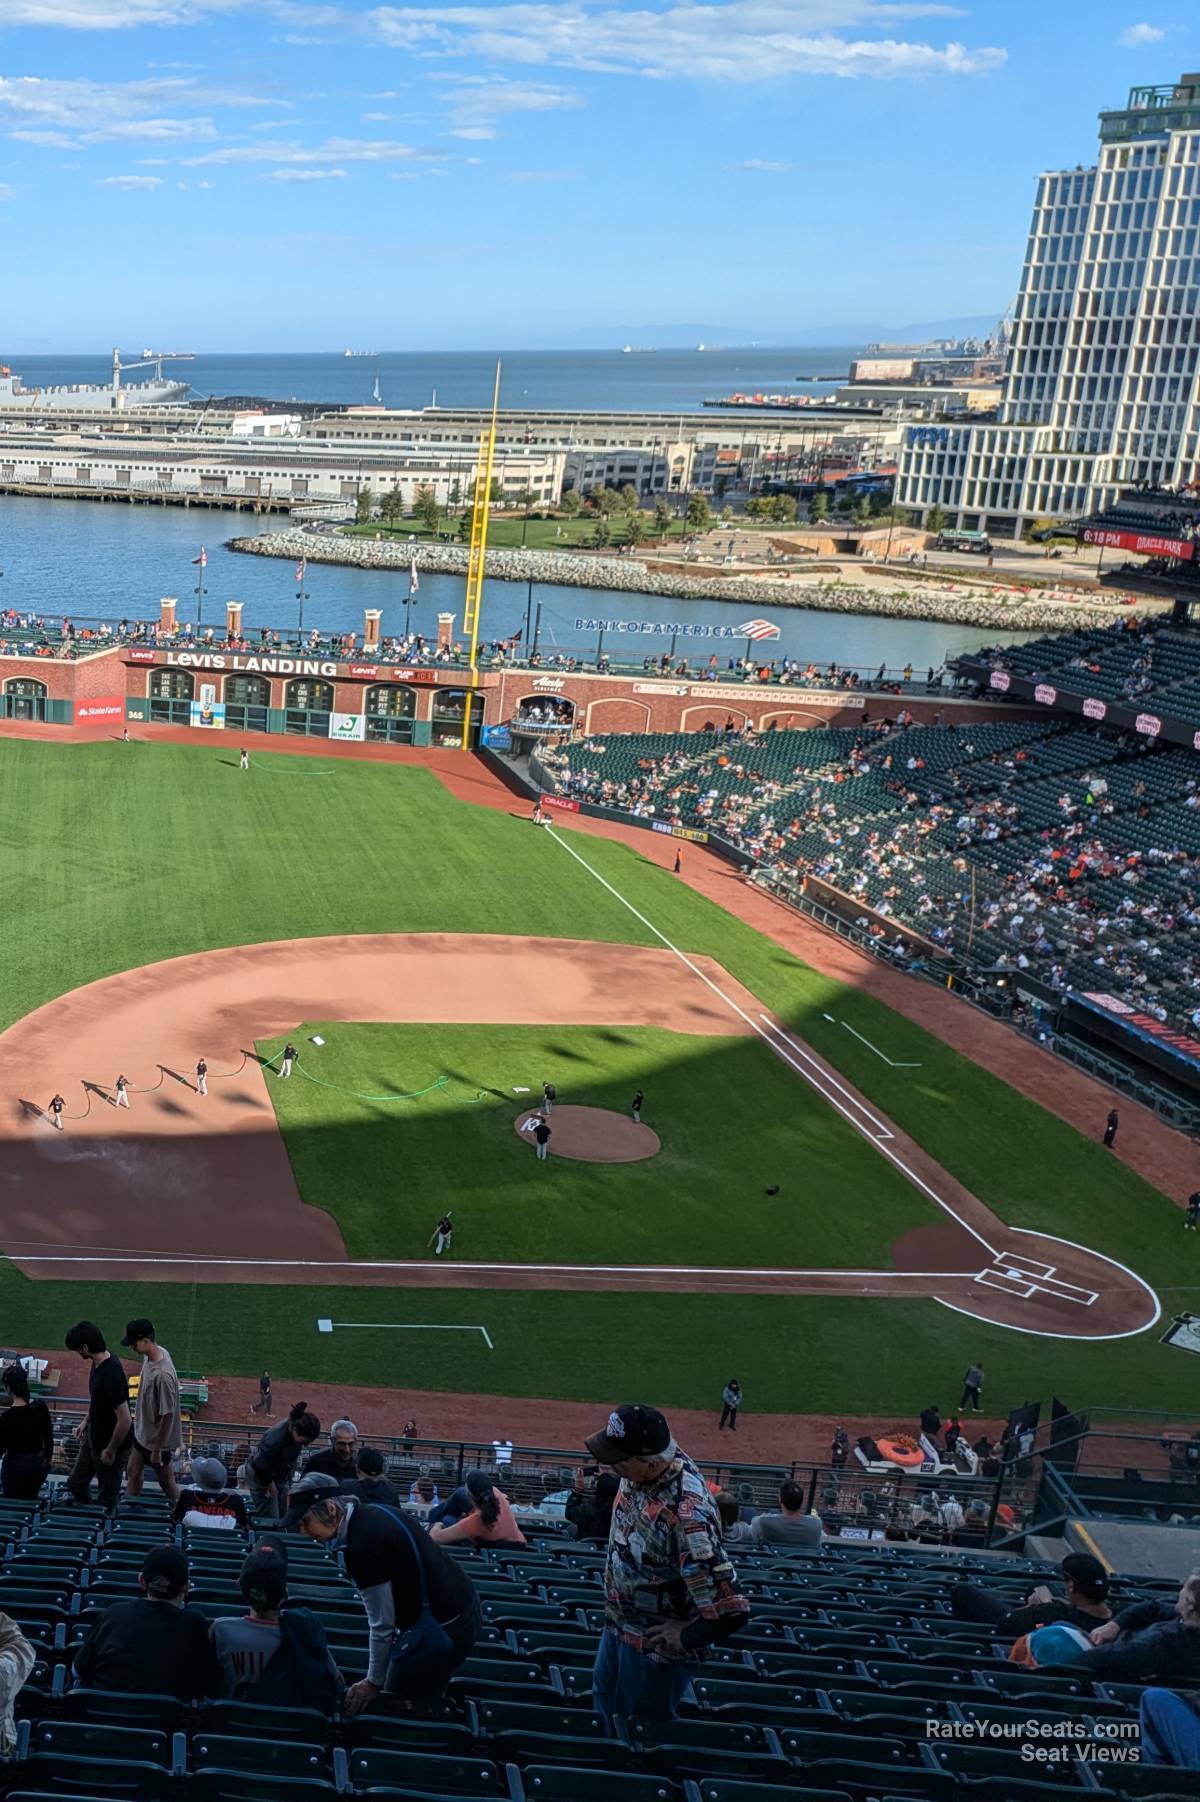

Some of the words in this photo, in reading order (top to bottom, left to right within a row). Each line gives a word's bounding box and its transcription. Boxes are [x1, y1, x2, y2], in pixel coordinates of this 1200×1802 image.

[1083, 530, 1105, 543] 6:18
[1105, 532, 1121, 546] PM
[1136, 536, 1162, 550] ORACLE
[1163, 540, 1183, 555] PARK
[575, 618, 621, 632] BANK
[627, 622, 647, 633] OF
[653, 623, 734, 638] AMERICA
[233, 656, 337, 676] LANDING
[532, 677, 566, 687] Alaska
[128, 711, 144, 719] 365
[443, 737, 462, 747] 309
[544, 797, 574, 809] ORACLE
